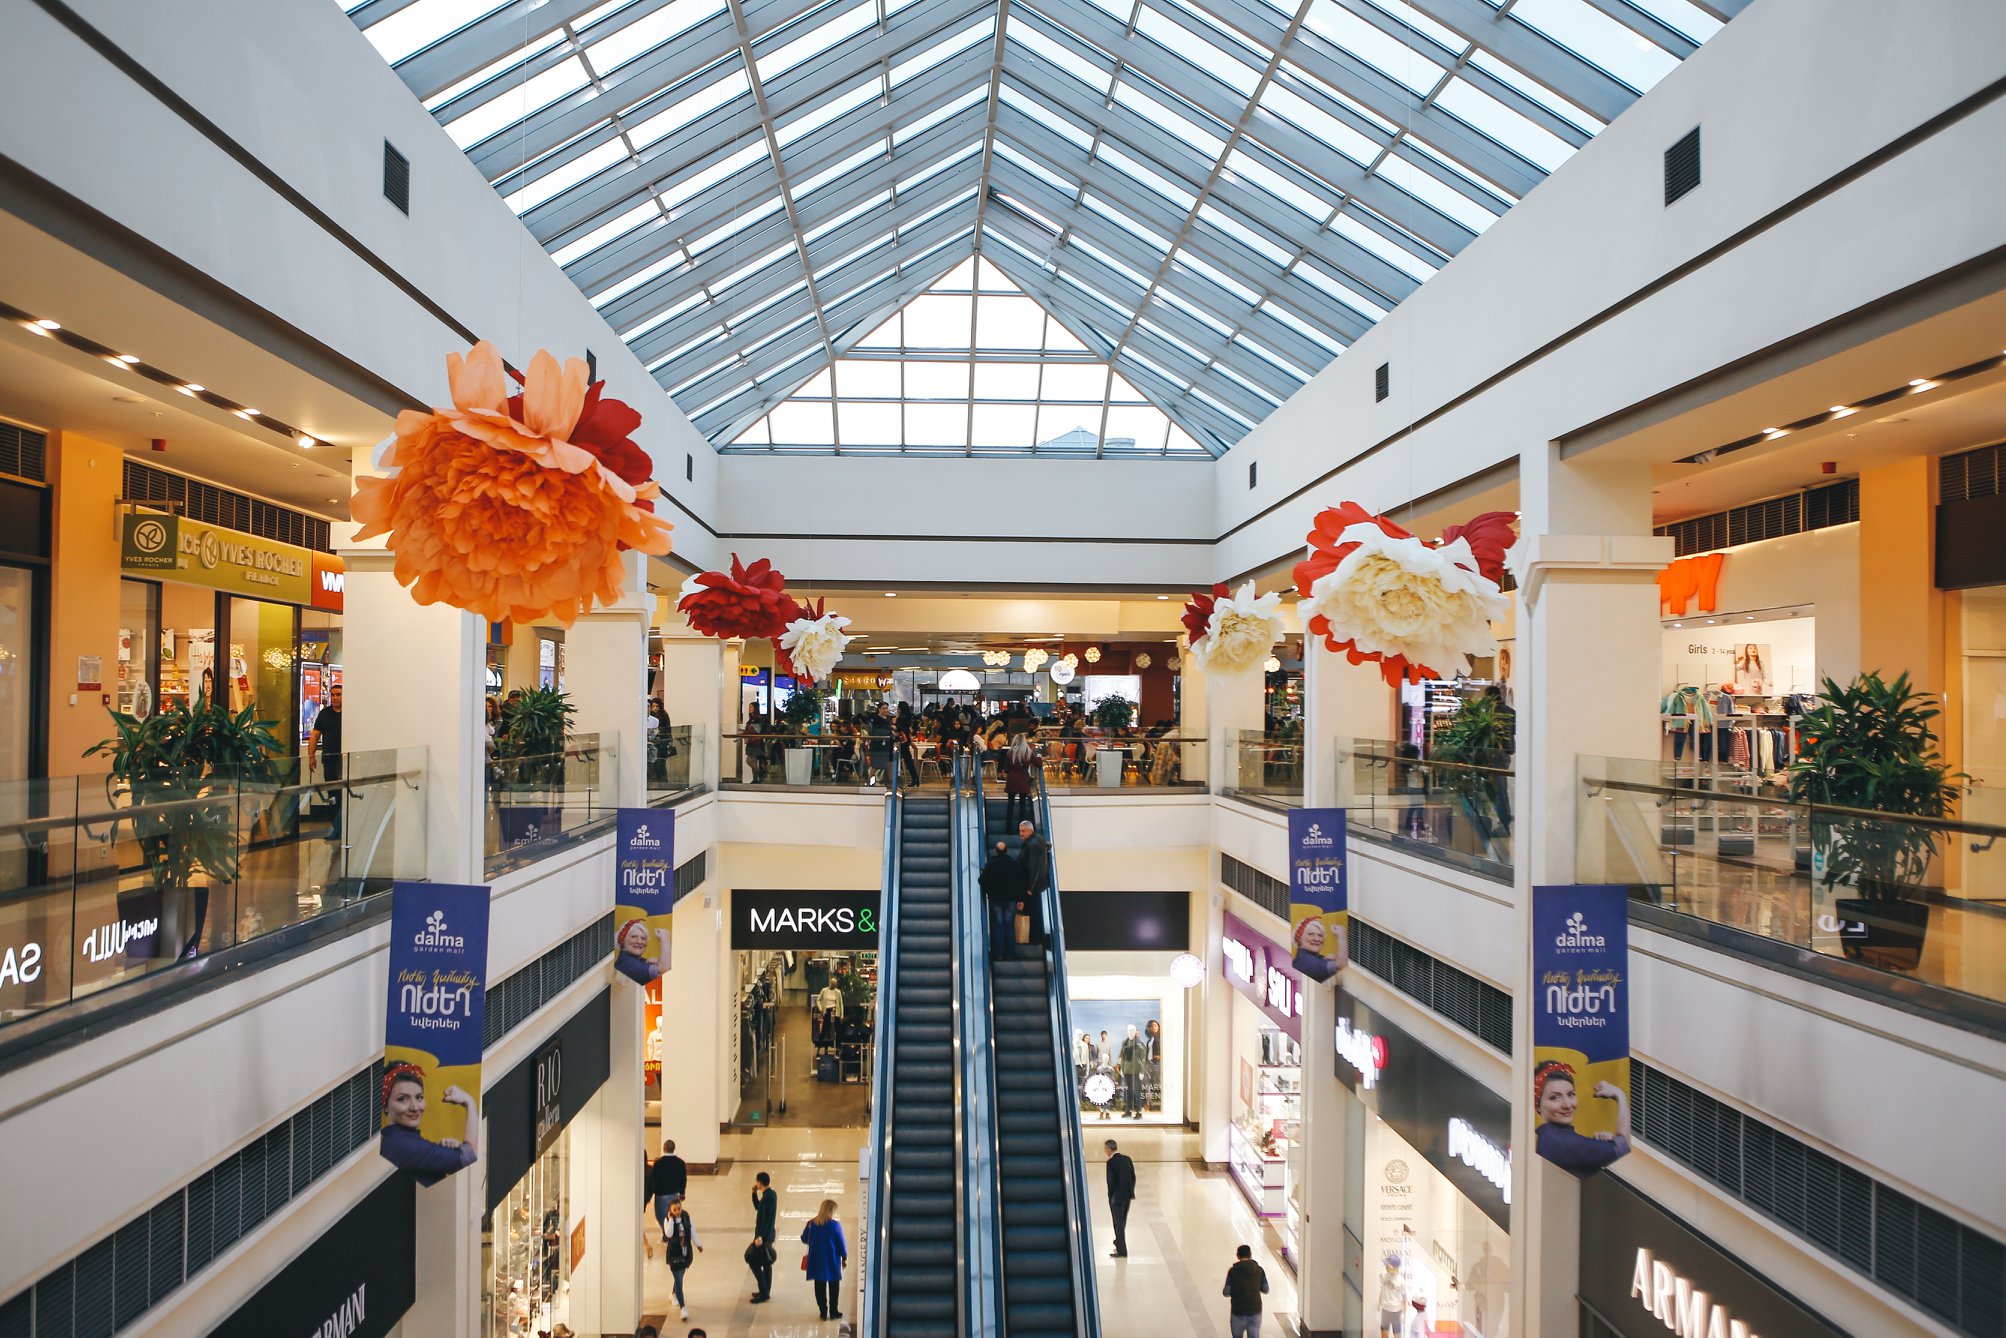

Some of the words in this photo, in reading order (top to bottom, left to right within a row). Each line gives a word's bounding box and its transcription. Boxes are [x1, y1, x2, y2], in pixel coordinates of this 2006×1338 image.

[144, 556, 173, 564] ROCHER
[219, 541, 254, 567] YVES
[255, 549, 303, 577] ROCHER
[1688, 644, 1708, 654] Girls
[630, 837, 660, 847] dalma
[1302, 836, 1333, 845] dalma
[750, 907, 855, 933] MARKS
[858, 908, 877, 933] &
[414, 931, 464, 948] dalma
[1556, 933, 1605, 947] dalma
[410, 1016, 460, 1030] նվերներ
[1557, 1016, 1606, 1028] նվերներ
[537, 1048, 561, 1112] RIO
[1381, 1185, 1413, 1193] VERSACE
[1631, 1246, 1759, 1338] ARM
[311, 1283, 366, 1338] MANI
